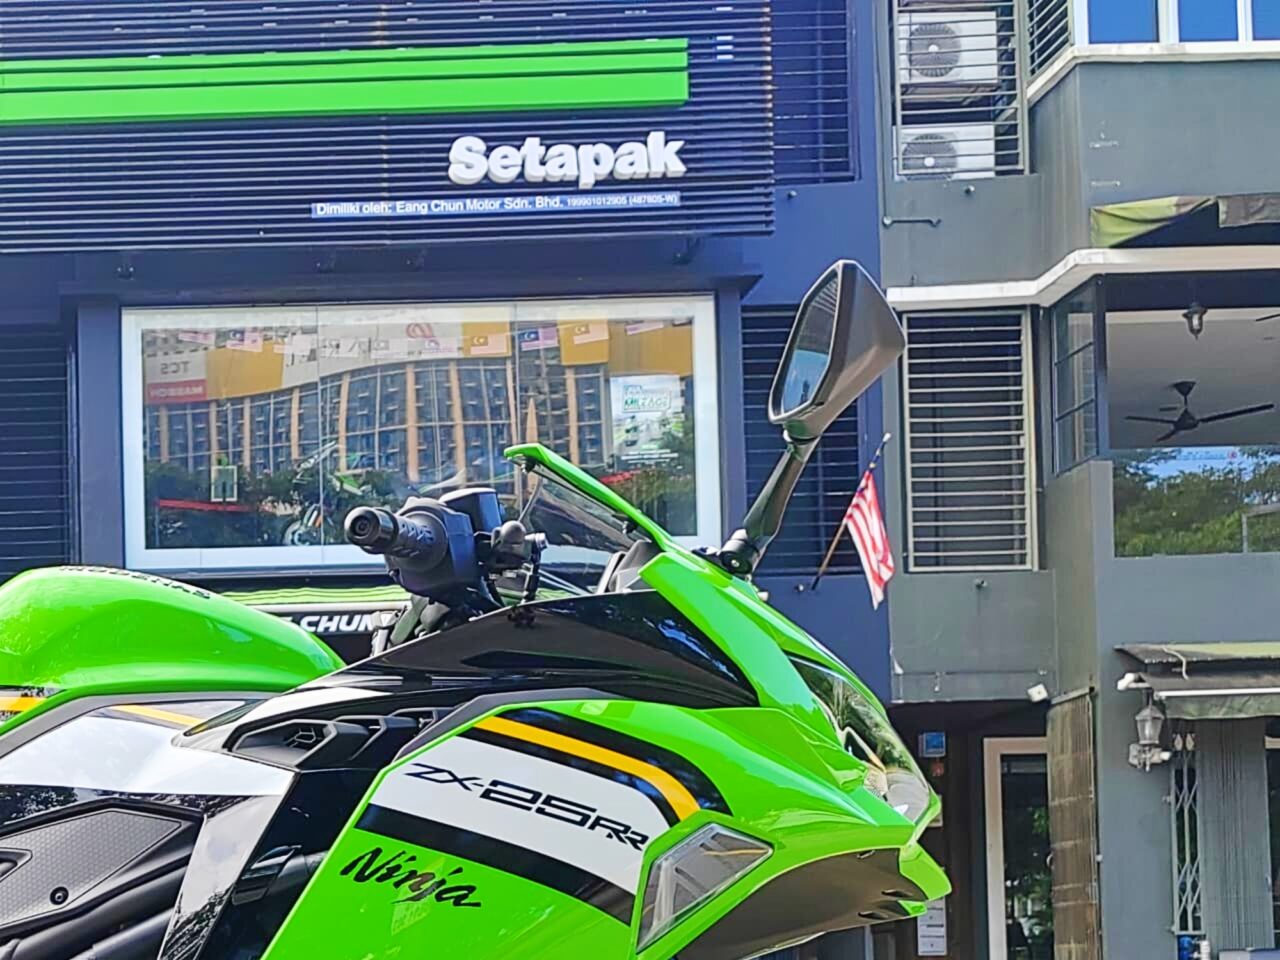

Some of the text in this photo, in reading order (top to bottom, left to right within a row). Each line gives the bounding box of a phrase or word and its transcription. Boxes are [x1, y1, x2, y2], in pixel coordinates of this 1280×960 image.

[448, 131, 687, 189] Setapak
[316, 202, 360, 215] Dimiliki
[362, 201, 392, 214] oleh:
[396, 200, 428, 214] Eang
[431, 199, 464, 212] Chun
[466, 198, 500, 211] Motor
[504, 197, 531, 210] Sdn.
[535, 196, 562, 209] Bhd.
[404, 763, 650, 851] ZX-25RR
[340, 847, 482, 907] Ninja
